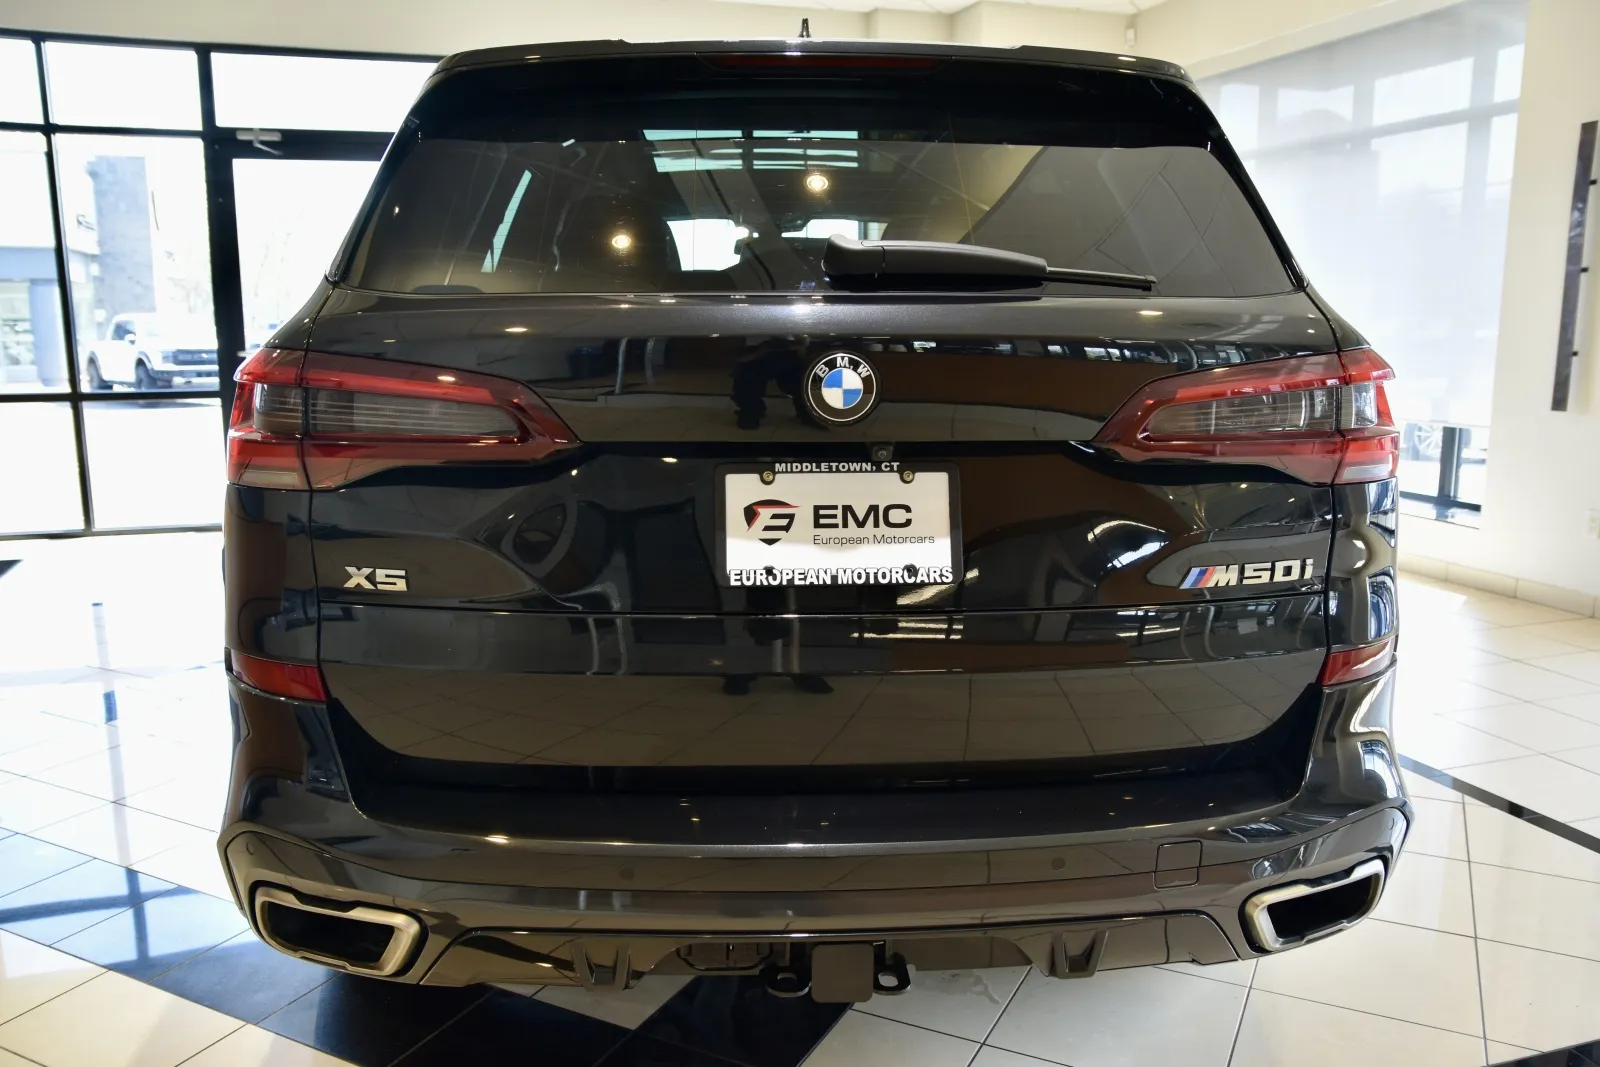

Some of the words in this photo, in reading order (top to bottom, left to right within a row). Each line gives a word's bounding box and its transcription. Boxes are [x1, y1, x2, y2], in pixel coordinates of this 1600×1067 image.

[815, 356, 870, 379] BMW
[775, 462, 876, 472] MIDDLETOWN,
[881, 462, 900, 471] CT
[813, 503, 913, 529] EMC
[813, 534, 870, 546] European
[873, 533, 935, 545] Motorcars
[343, 566, 407, 591] X5
[729, 568, 832, 586] EUROPEAN
[837, 566, 953, 584] MOTORCARS
